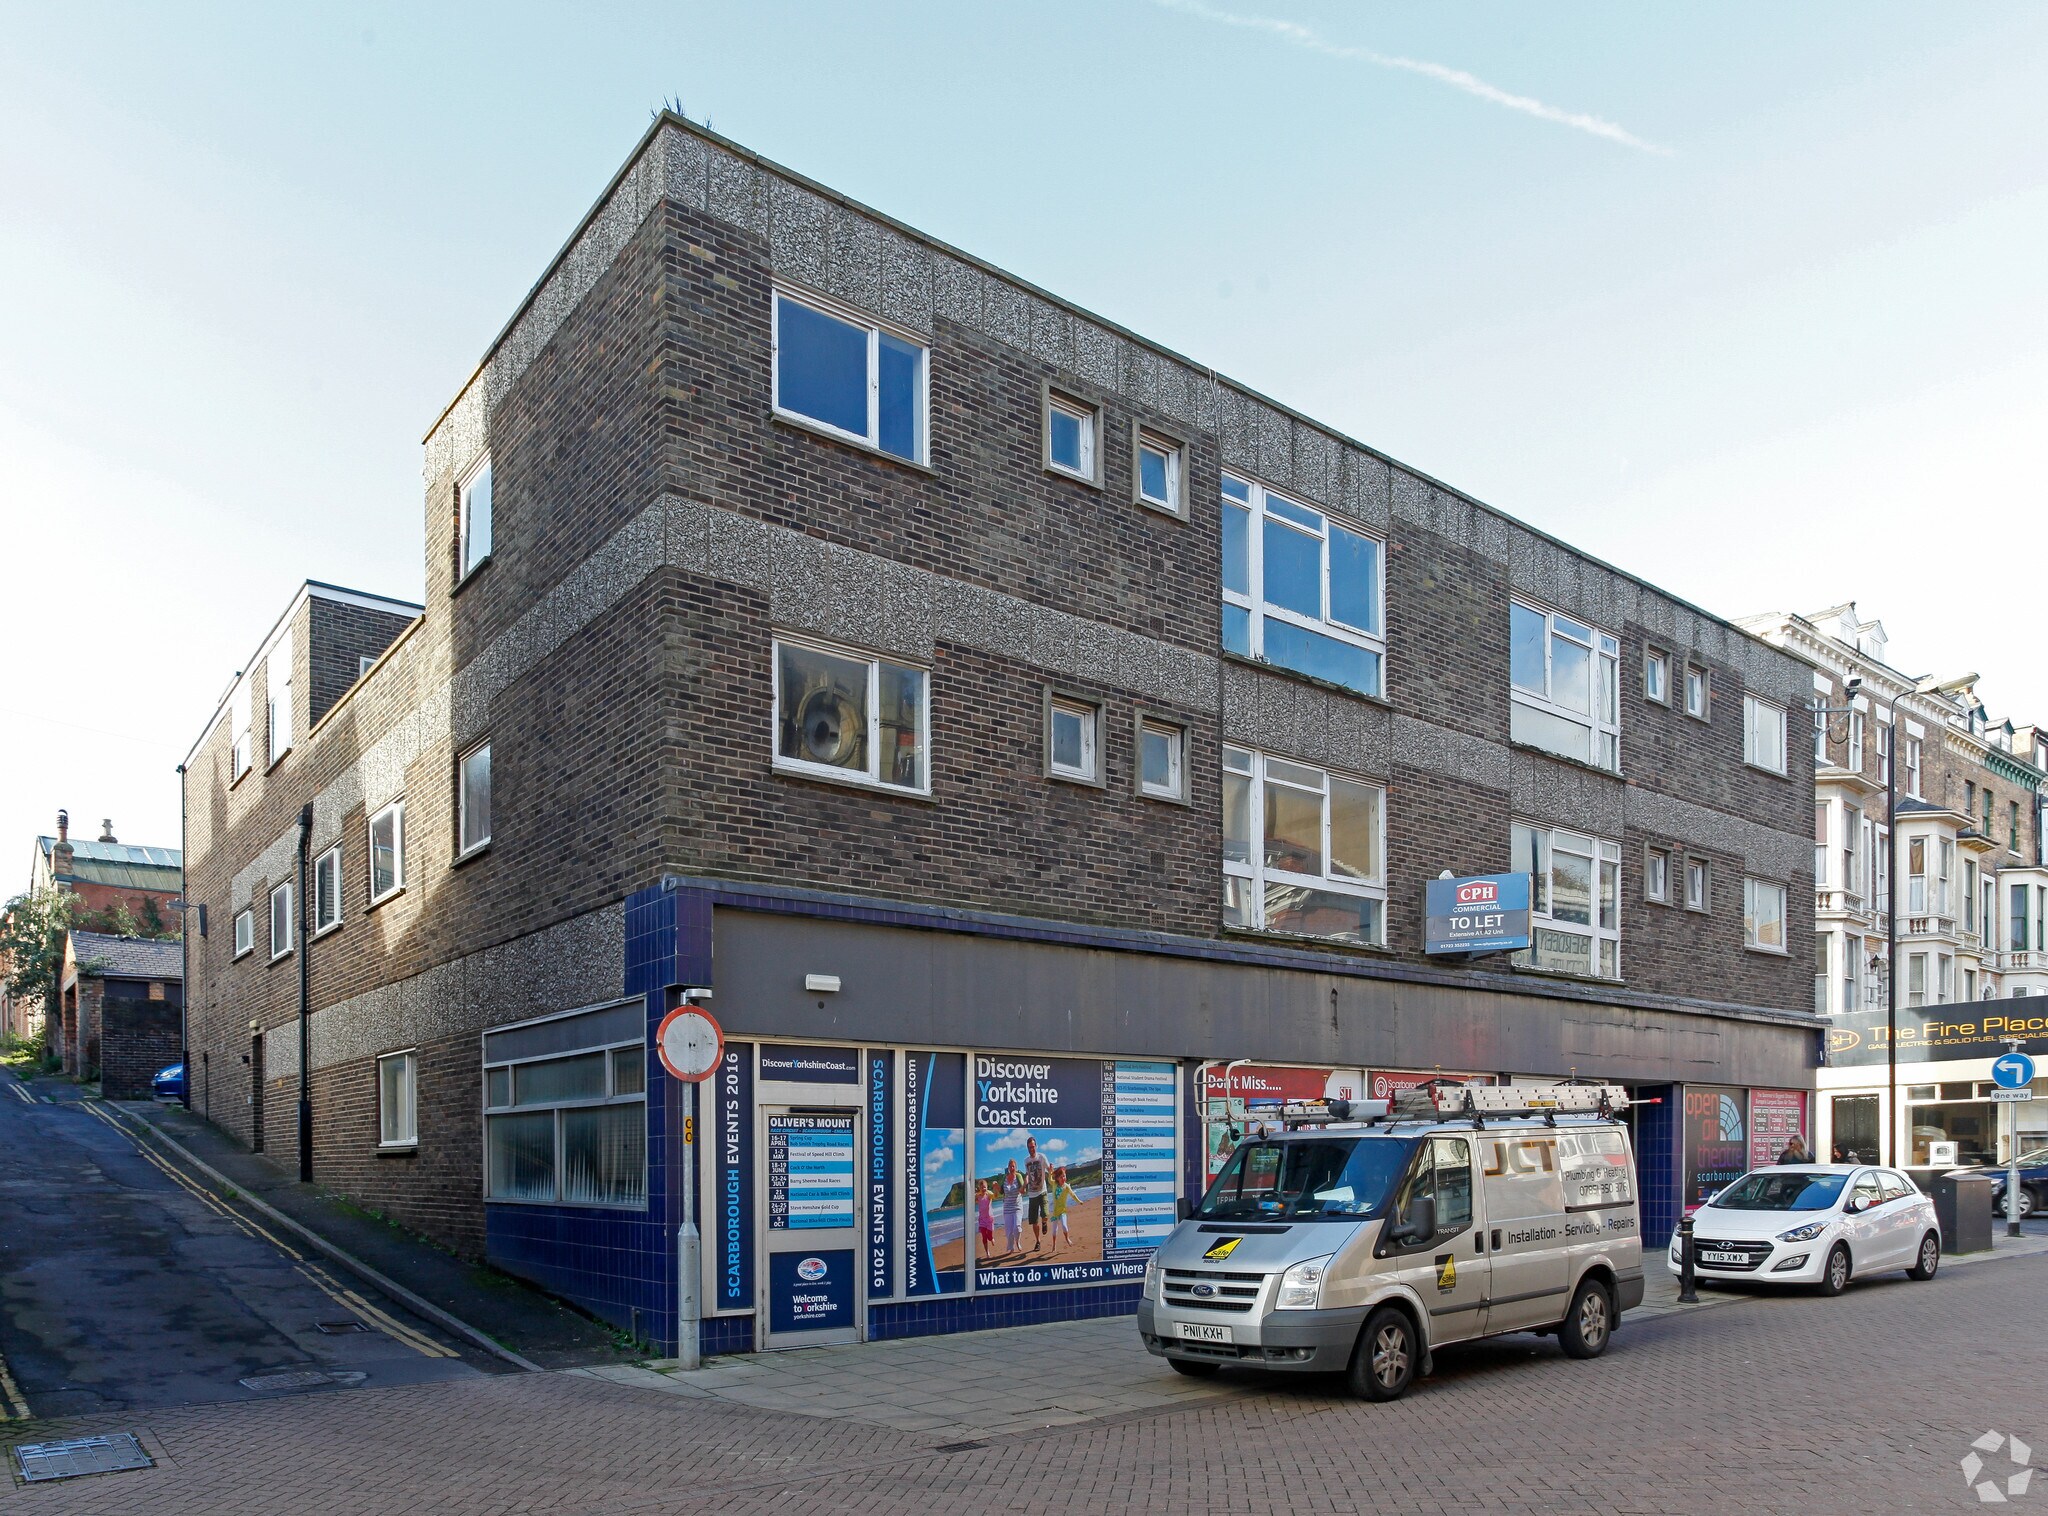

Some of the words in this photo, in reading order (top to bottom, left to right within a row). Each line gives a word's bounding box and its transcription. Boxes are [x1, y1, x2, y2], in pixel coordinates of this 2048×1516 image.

[1460, 886, 1493, 900] CPH
[1453, 904, 1501, 913] COMMERCIAL
[1449, 918, 1470, 930] TO
[1475, 914, 1504, 928] LET
[1868, 1026, 1916, 1042] The
[1923, 1020, 1975, 1038] Fire
[1891, 1040, 1932, 1048] LECTRIC
[726, 1053, 739, 1095] 2016
[762, 1059, 856, 1071] DiscoverYorkshireCoast.com
[977, 1057, 1050, 1080] Discover
[977, 1080, 1058, 1104] Yorkshire
[1208, 1074, 1239, 1089] Don't
[977, 1105, 1052, 1126] Coast.com
[1686, 1093, 1720, 1120] open
[770, 1118, 815, 1128] OLIVER'S
[817, 1119, 852, 1128] MOUNT
[873, 1060, 884, 1179] SCARBOROUGH
[1702, 1119, 1720, 1141] air
[727, 1100, 739, 1164] EVENTS
[1485, 1140, 1556, 1177] JCT
[1697, 1146, 1744, 1168] theatre
[907, 1060, 919, 1288] www.discoveryorkshirecoast.com
[1566, 1169, 1595, 1181] Plumbing
[1603, 1167, 1626, 1179] Heating
[1601, 1183, 1613, 1194] 350
[874, 1185, 884, 1244] EVENTS
[728, 1169, 740, 1297] SCARBOROUGH
[1437, 1227, 1460, 1235] TRANSIT
[1508, 1226, 1556, 1244] Installation
[1565, 1222, 1600, 1236] Servicing
[1608, 1216, 1635, 1232] Repairs
[1707, 1253, 1725, 1261] YY15
[874, 1248, 885, 1288] 2016
[979, 1271, 1010, 1286] What
[1013, 1271, 1024, 1283] to
[1028, 1269, 1041, 1282] do
[1051, 1266, 1088, 1280] What's
[1090, 1267, 1103, 1277] on
[1111, 1263, 1144, 1276] Where
[1442, 1274, 1455, 1284] safe
[793, 1295, 828, 1304] Welcome
[794, 1305, 802, 1313] to
[803, 1302, 838, 1312] Yorkshire
[1203, 1327, 1223, 1340] KXH
